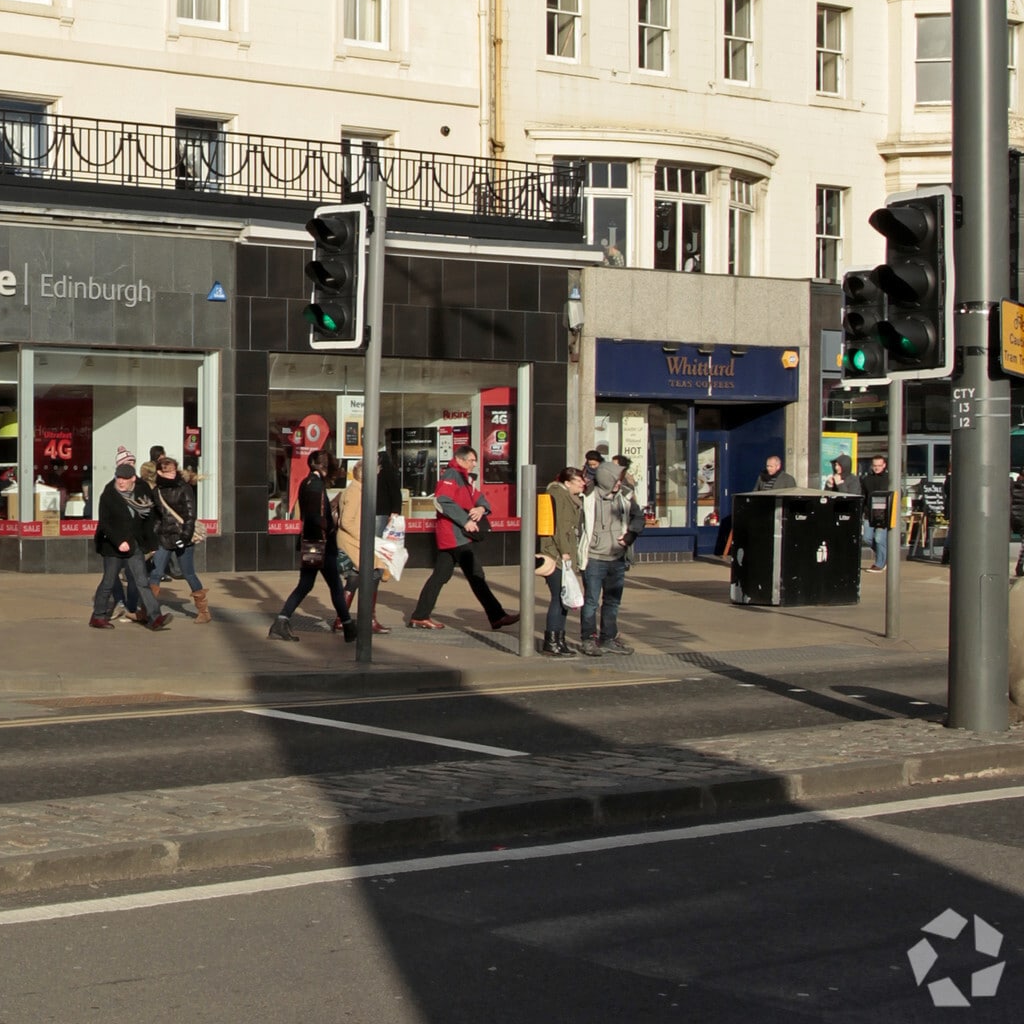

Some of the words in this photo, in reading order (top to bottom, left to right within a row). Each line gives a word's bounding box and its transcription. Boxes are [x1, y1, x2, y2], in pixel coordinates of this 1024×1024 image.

[40, 273, 151, 308] Edinburgh
[666, 356, 735, 377] Whittard
[953, 388, 976, 399] CTY
[959, 403, 970, 413] 13
[491, 414, 508, 425] 4G
[959, 417, 971, 427] 12
[44, 439, 73, 460] 4G
[624, 447, 642, 455] HOT
